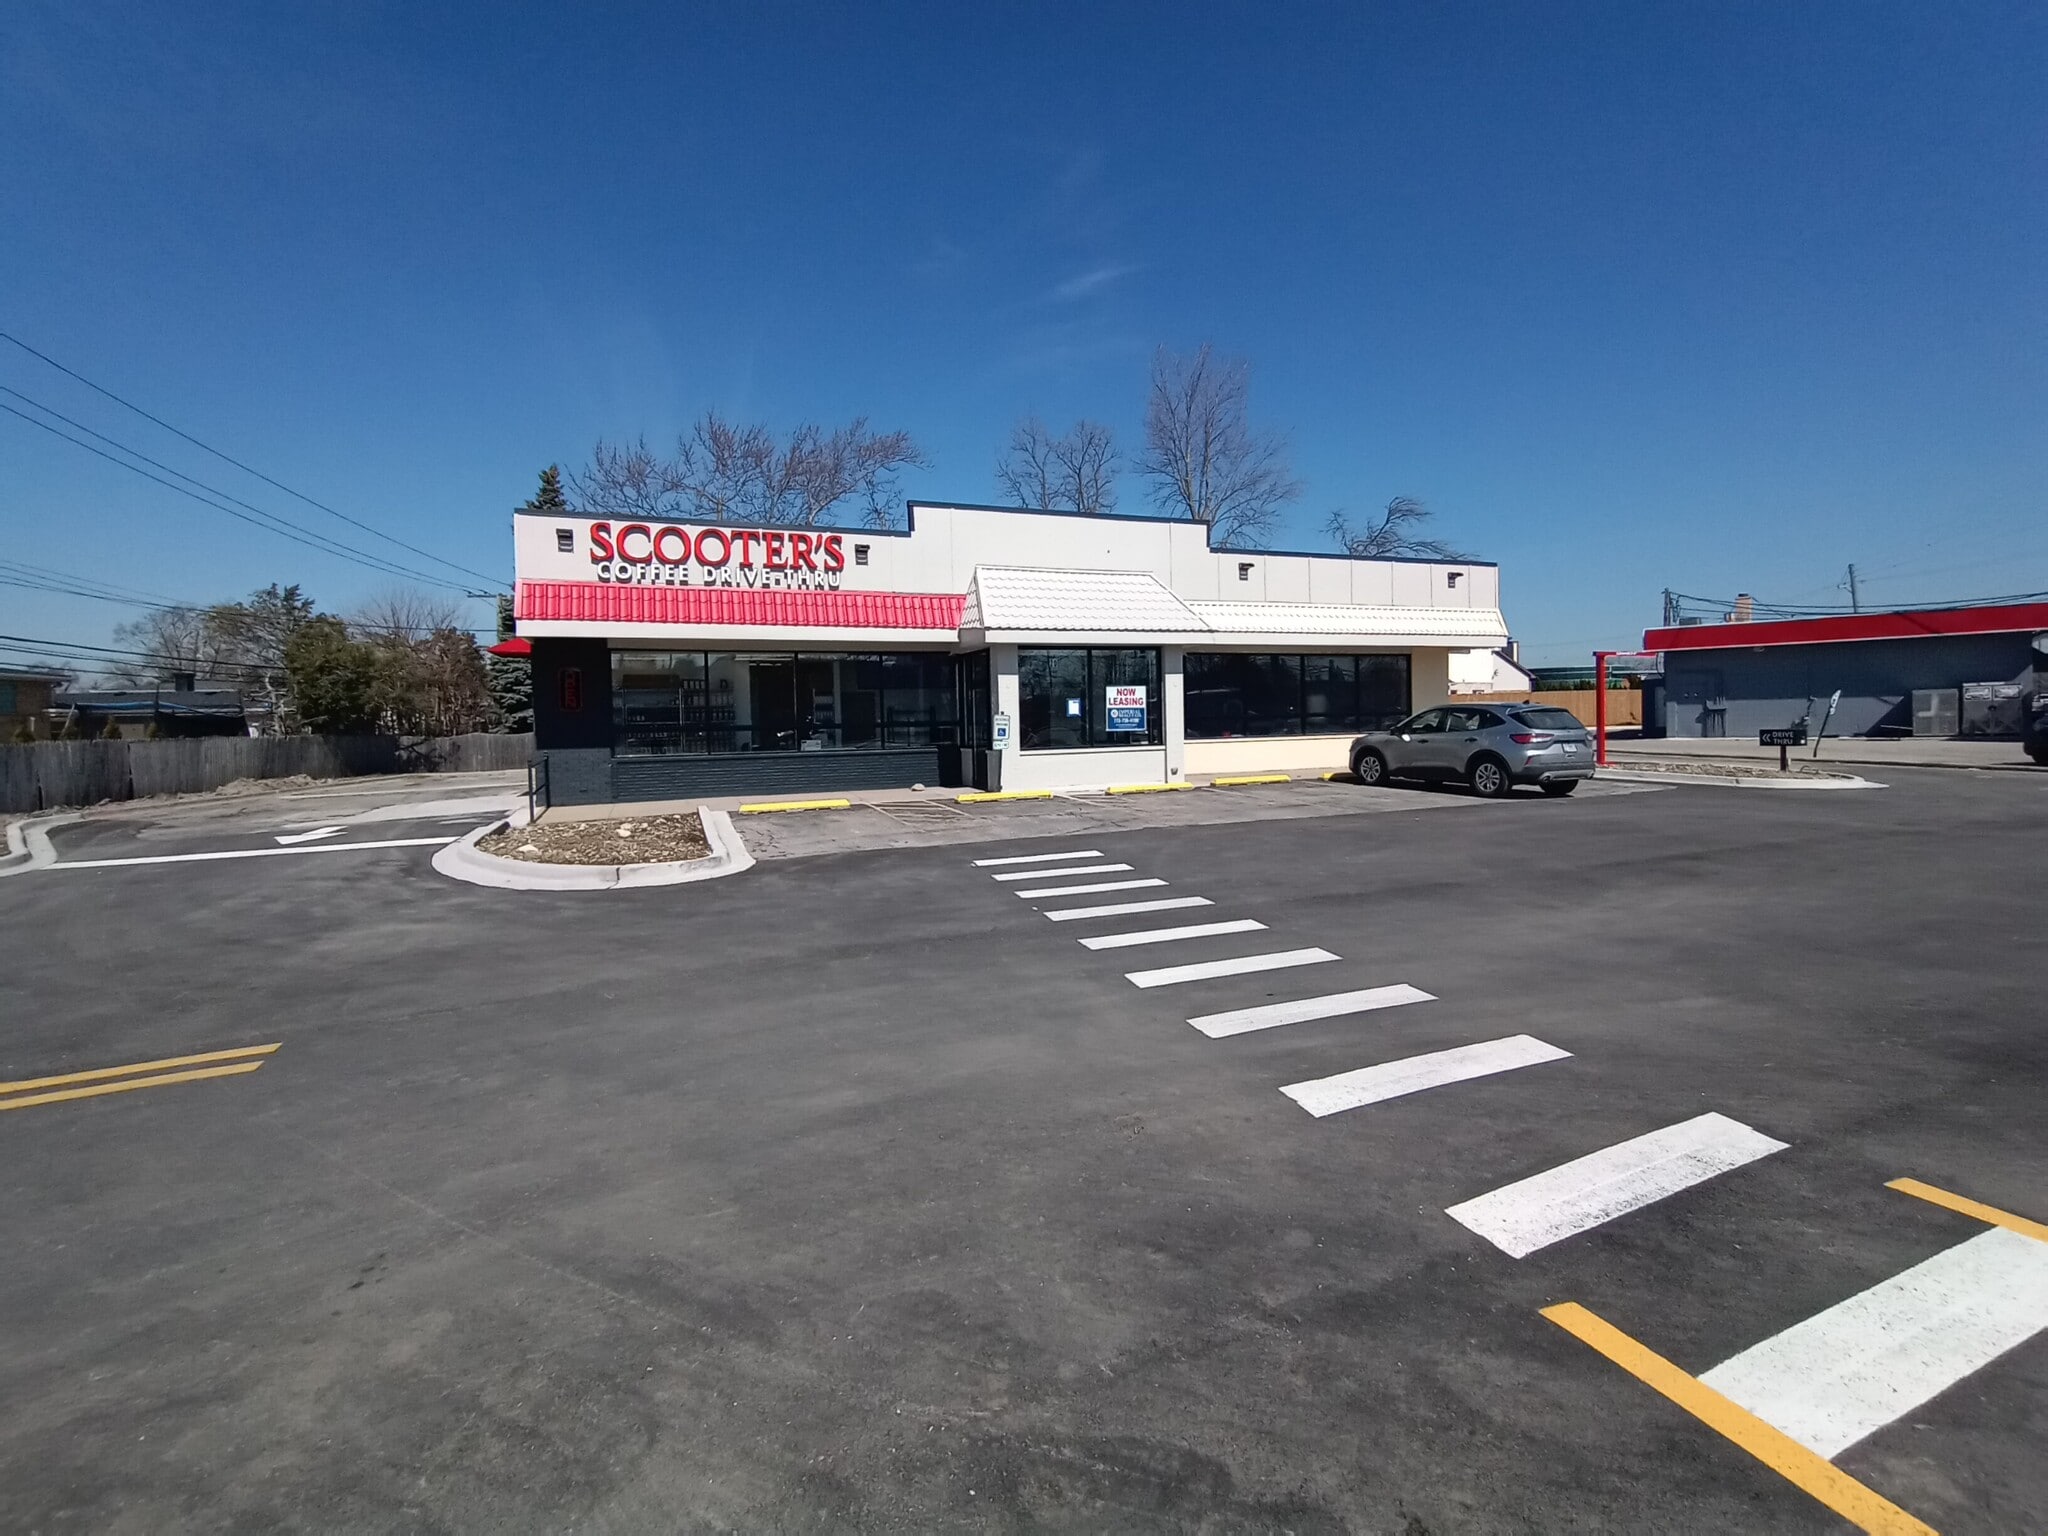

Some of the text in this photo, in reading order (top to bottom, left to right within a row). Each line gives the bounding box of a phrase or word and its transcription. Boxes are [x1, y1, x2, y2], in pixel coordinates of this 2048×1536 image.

[590, 522, 845, 570] SCOOTER'S
[597, 561, 689, 581] COFFEE
[1116, 688, 1136, 696] NOW
[1108, 697, 1144, 706] LEASING
